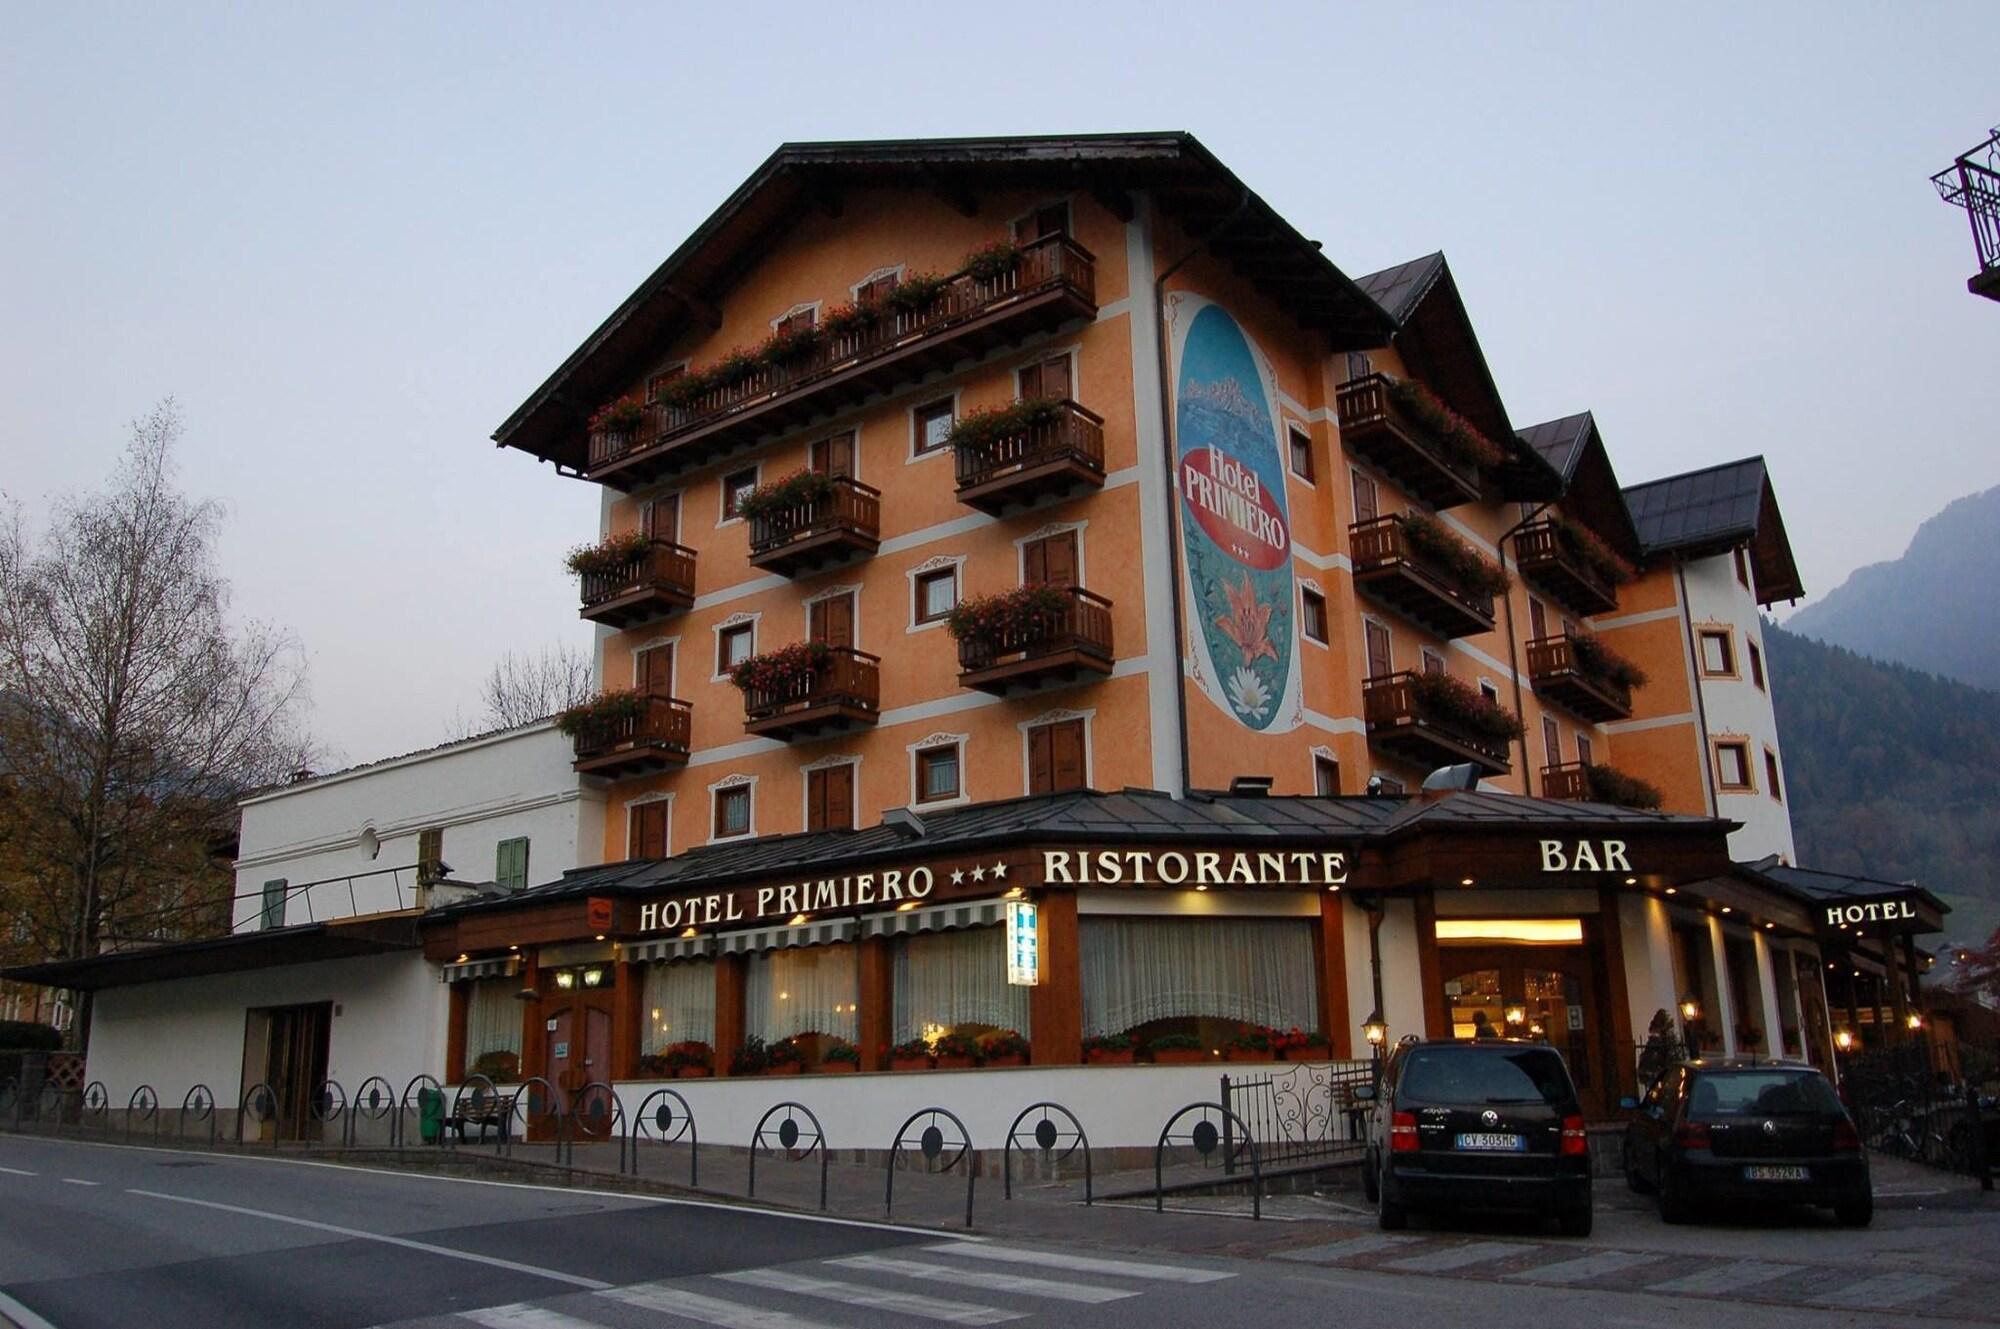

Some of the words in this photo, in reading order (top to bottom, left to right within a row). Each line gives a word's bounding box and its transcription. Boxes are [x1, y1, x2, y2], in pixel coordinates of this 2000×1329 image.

[1208, 442, 1261, 505] Hotel
[1184, 464, 1285, 550] PRIMIERO
[1042, 851, 1348, 884] RISTORANTE
[1540, 840, 1632, 872] BAR
[640, 893, 743, 931] HOTEL
[757, 866, 934, 917] PRIMIERO
[1827, 901, 1916, 925] HOTEL
